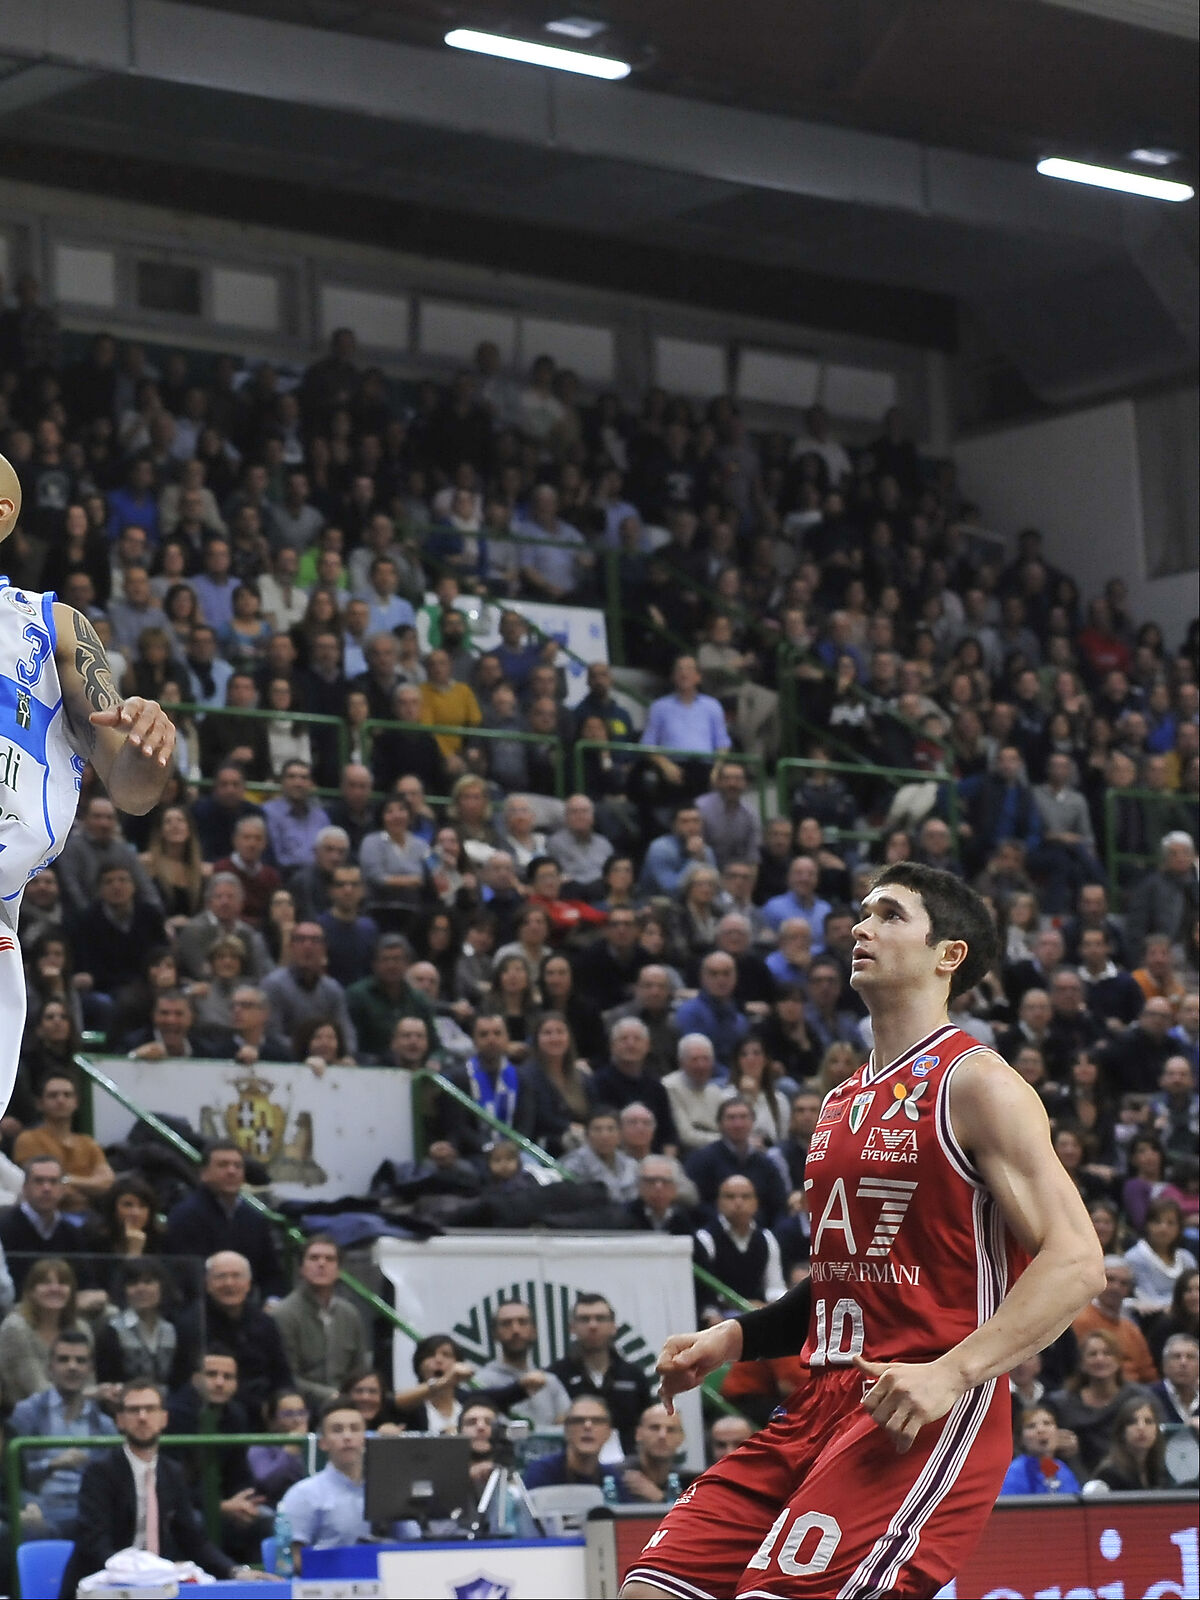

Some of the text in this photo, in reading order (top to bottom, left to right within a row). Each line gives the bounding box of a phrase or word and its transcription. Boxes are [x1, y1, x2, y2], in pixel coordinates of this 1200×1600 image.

[16, 622, 52, 688] 3
[860, 1150, 918, 1164] EYEWEAR
[804, 1177, 918, 1256] A7
[847, 1262, 921, 1286] ARMANI
[810, 1299, 864, 1366] 10
[747, 1508, 842, 1576] 10
